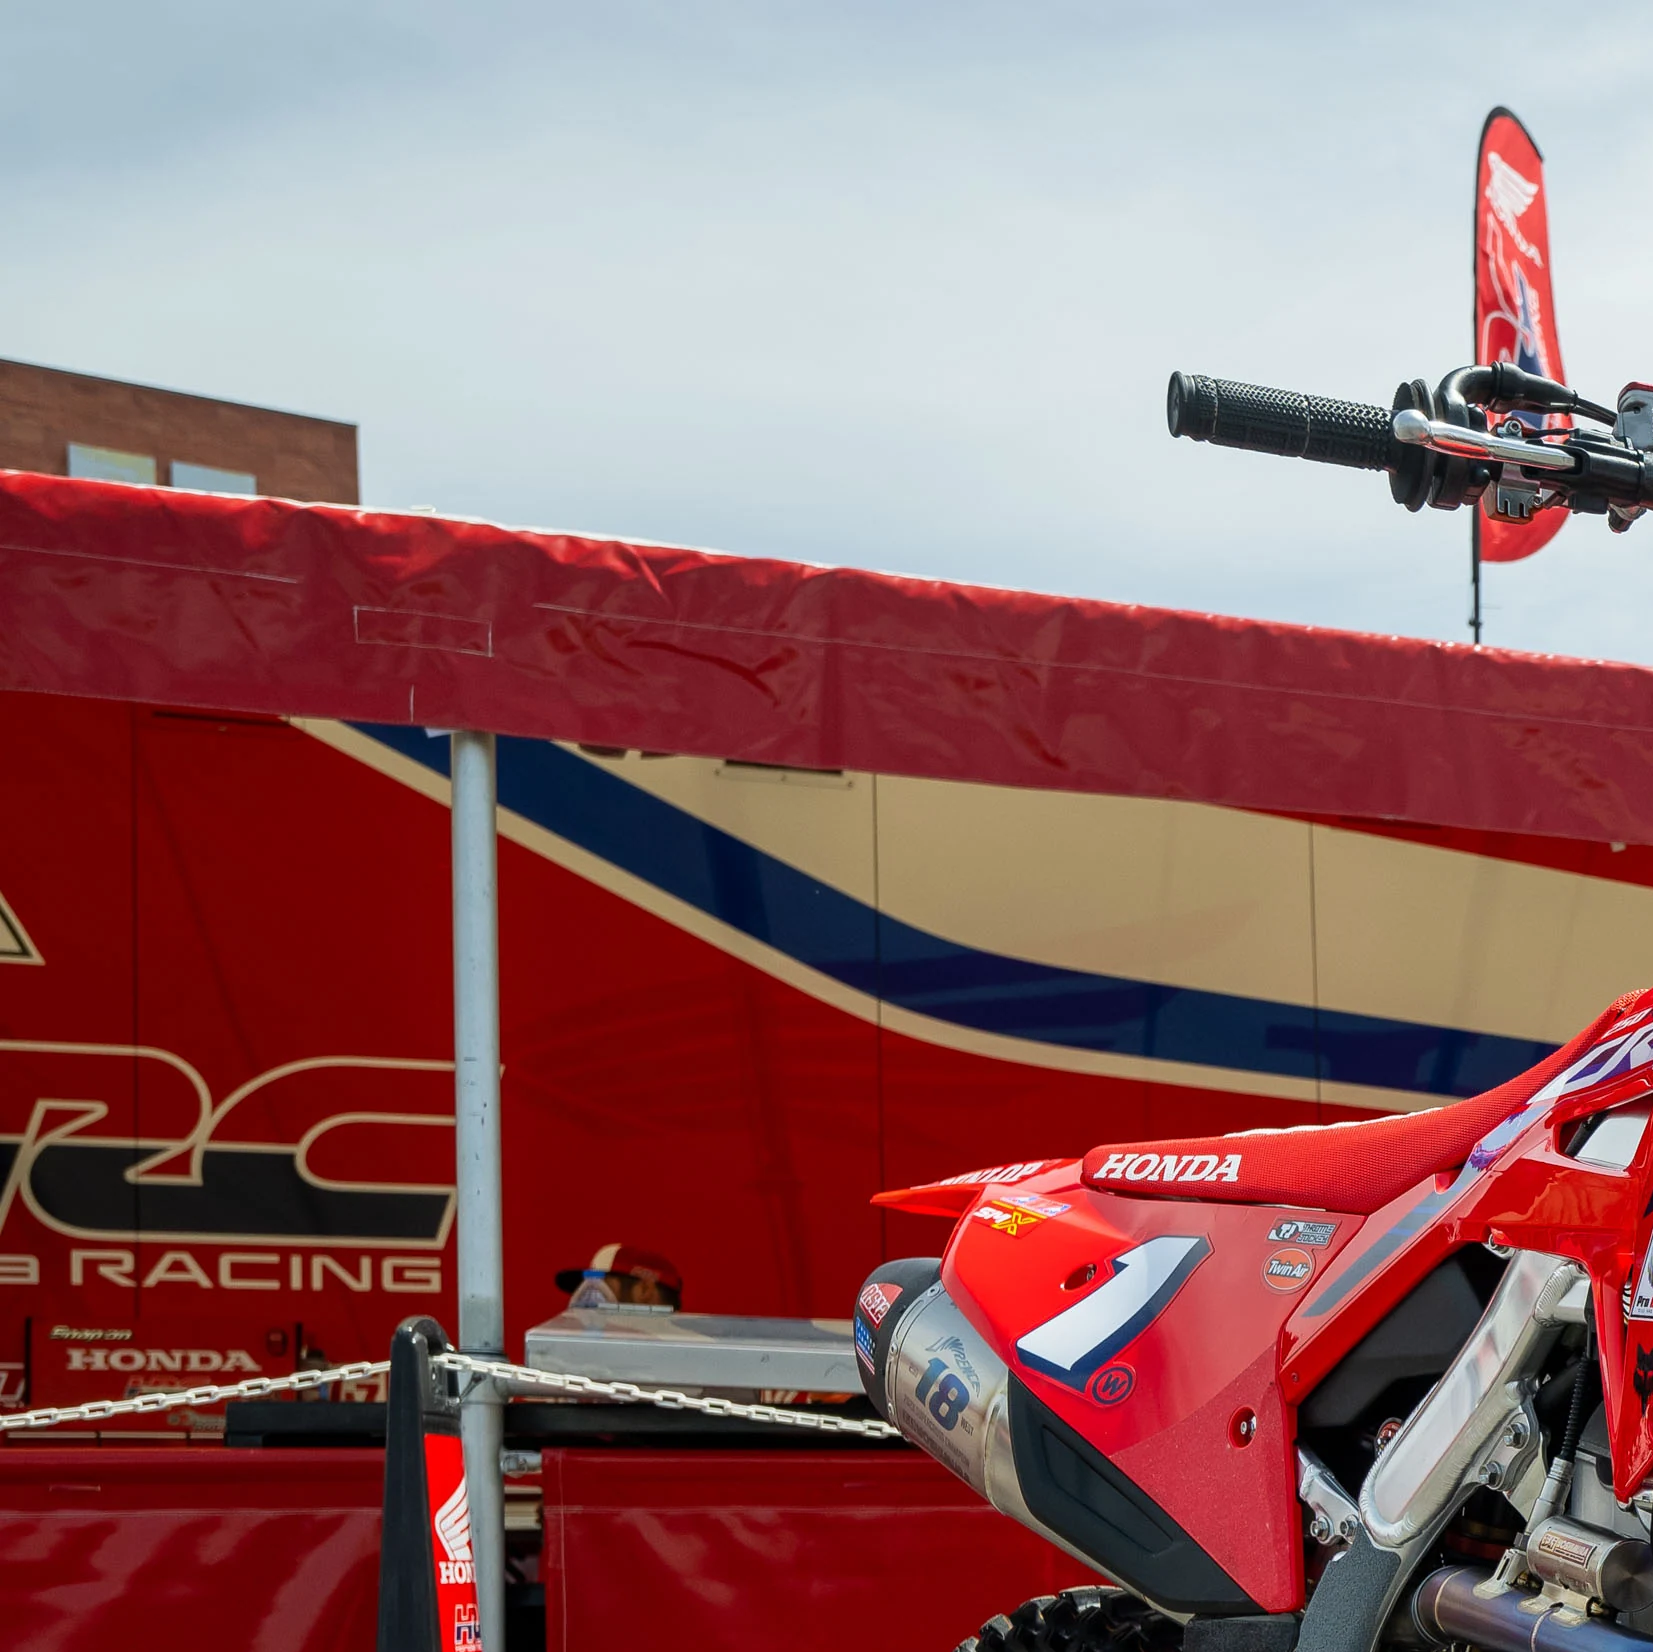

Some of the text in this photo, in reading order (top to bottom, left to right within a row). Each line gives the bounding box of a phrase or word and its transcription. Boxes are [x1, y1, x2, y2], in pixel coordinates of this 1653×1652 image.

[0, 1038, 505, 1251] RC
[1093, 1154, 1242, 1182] HONDA
[973, 1207, 1038, 1236] SMX
[70, 1249, 442, 1293] RACING
[1268, 1261, 1311, 1279] Twin Air
[1017, 1236, 1201, 1371] 1
[1636, 1296, 1650, 1308] Pro
[67, 1349, 262, 1371] HONDA
[916, 1357, 970, 1431] 18
[439, 1561, 476, 1584] HON
